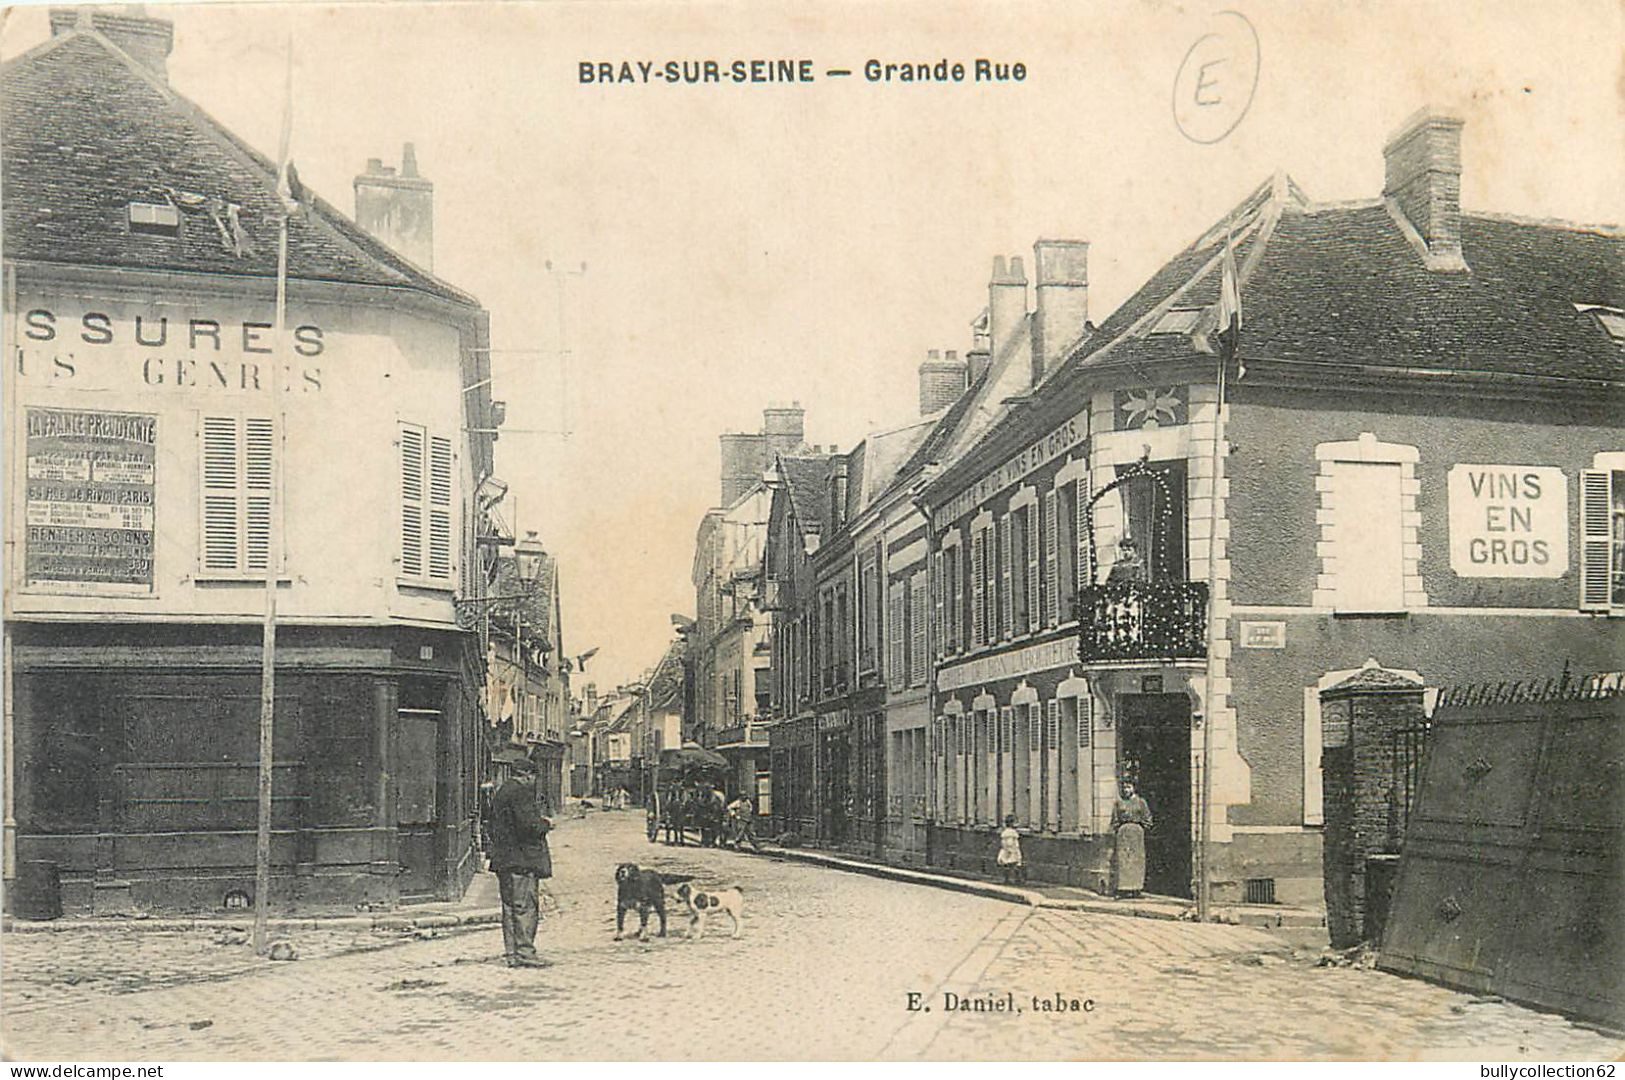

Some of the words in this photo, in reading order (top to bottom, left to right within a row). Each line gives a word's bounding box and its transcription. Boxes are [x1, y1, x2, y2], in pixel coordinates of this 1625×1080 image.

[1468, 472, 1541, 499] VINS
[1487, 506, 1531, 532] EN
[1470, 538, 1548, 565] GROS
